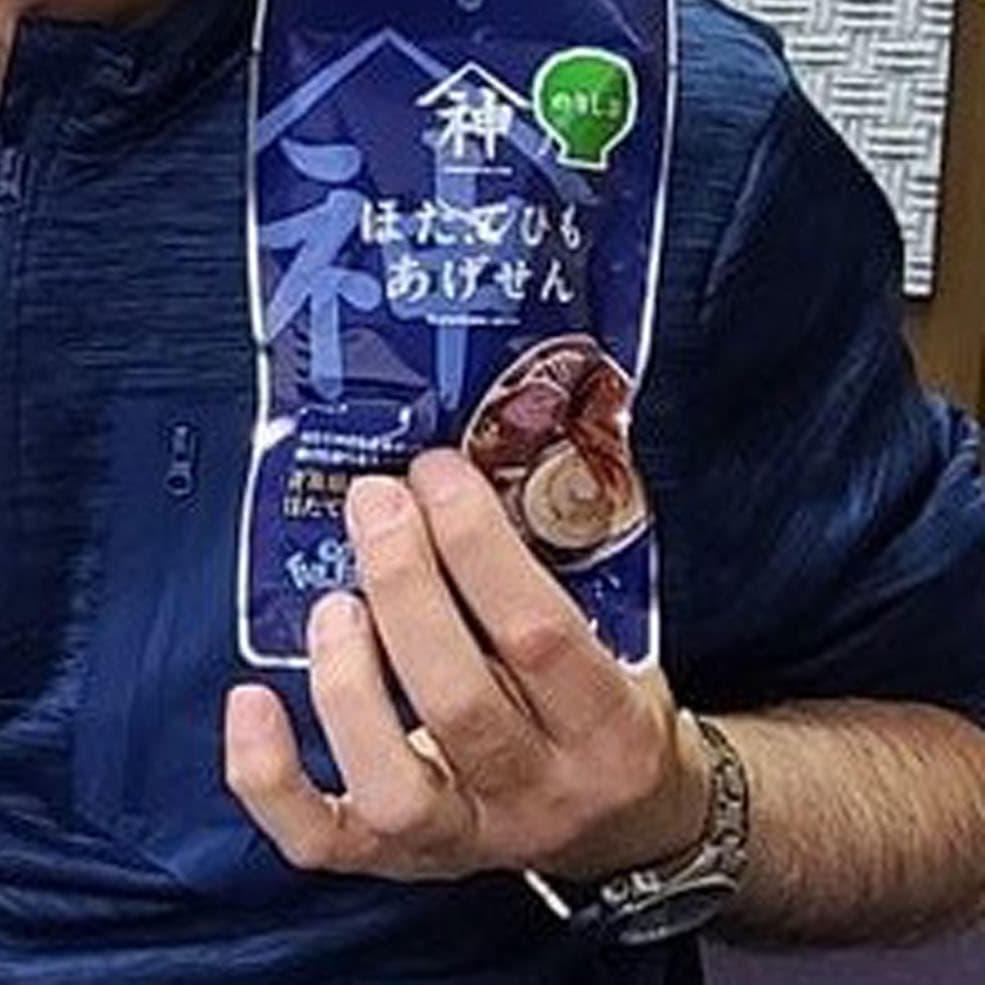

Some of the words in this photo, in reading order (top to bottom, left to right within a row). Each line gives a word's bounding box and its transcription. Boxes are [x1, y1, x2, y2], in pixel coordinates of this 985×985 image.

[436, 86, 514, 159] 神
[359, 198, 583, 249] ほたてひも
[385, 256, 576, 303] あげせん
